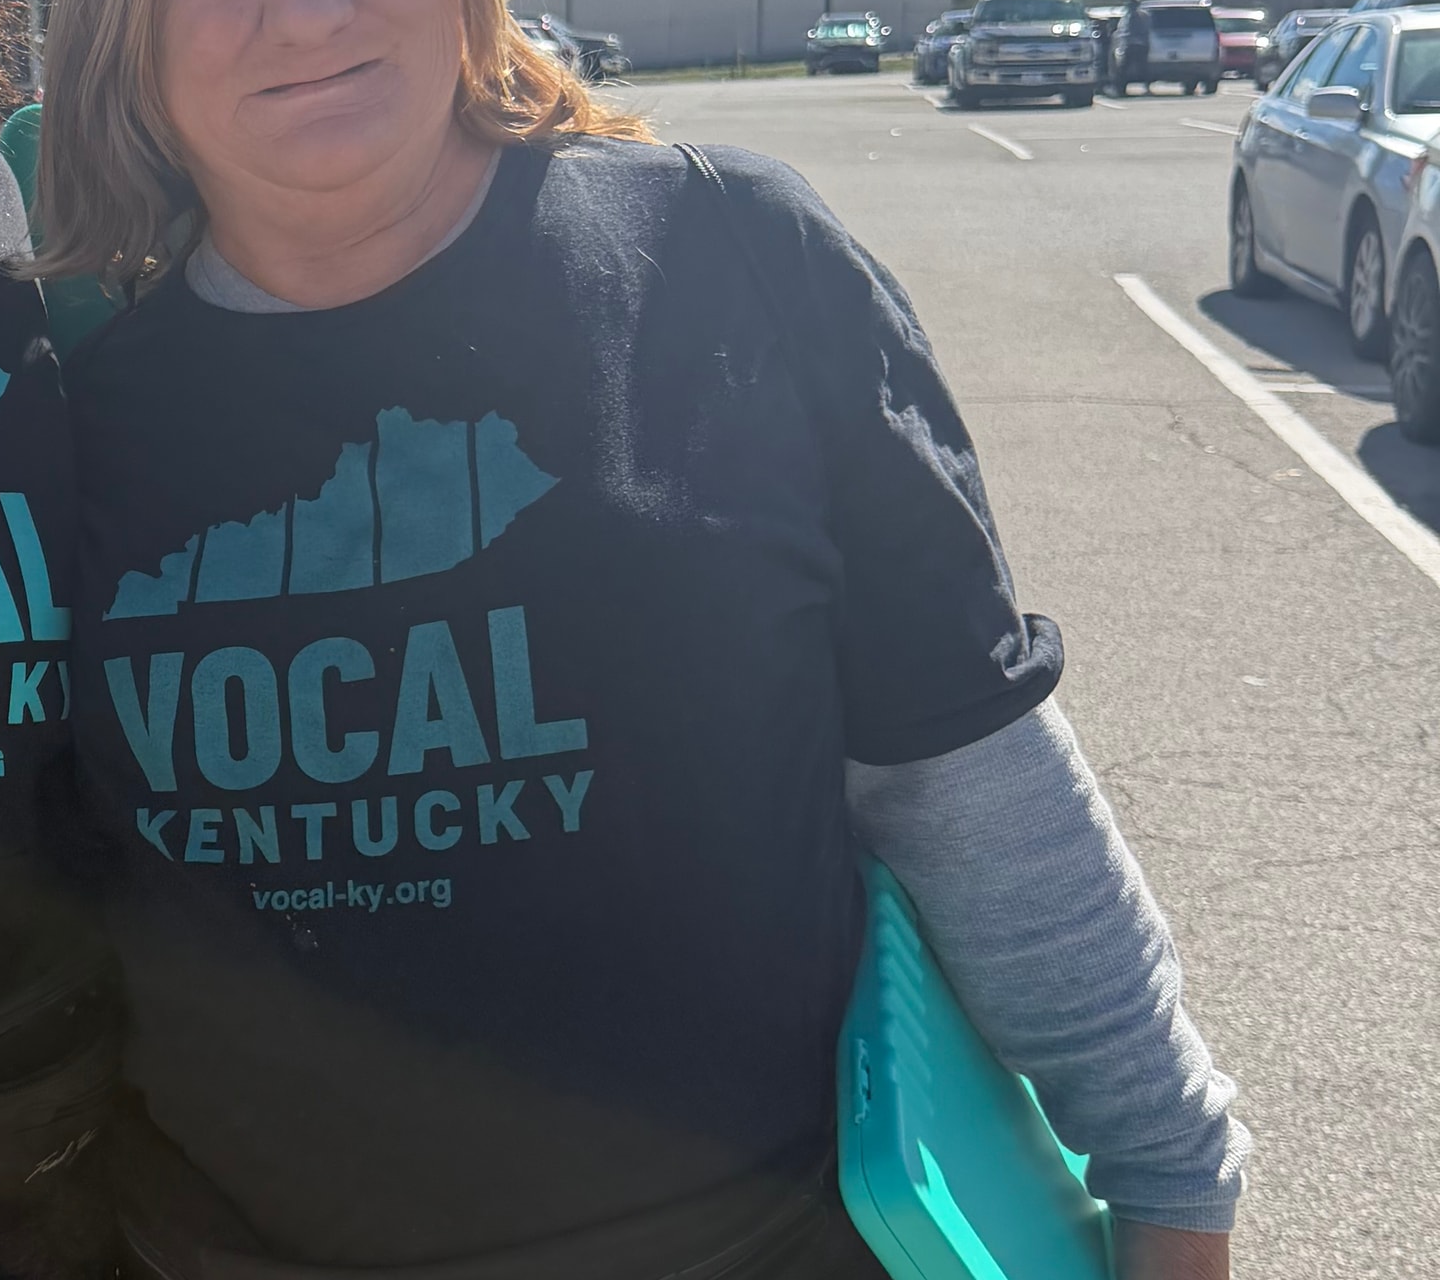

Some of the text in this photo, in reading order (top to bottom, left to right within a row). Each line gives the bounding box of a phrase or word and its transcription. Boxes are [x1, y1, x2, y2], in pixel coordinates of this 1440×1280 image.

[103, 604, 589, 792] VOCAL
[136, 769, 595, 865] KENTUCKY
[252, 878, 452, 913] vocal-ky.org
